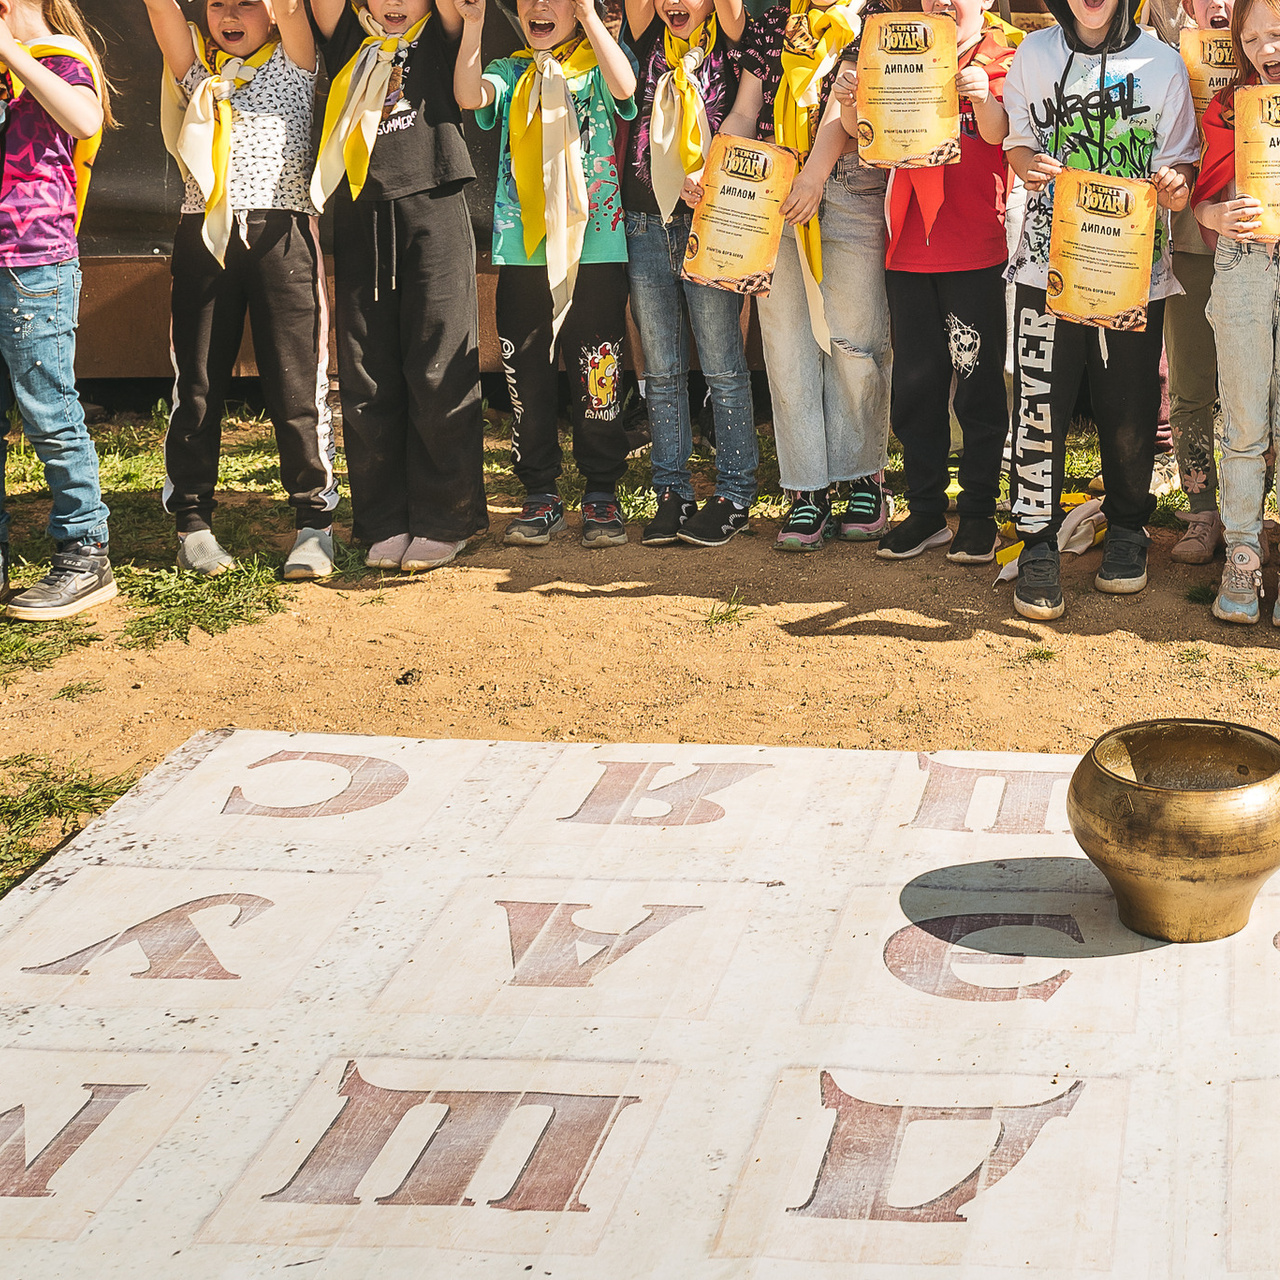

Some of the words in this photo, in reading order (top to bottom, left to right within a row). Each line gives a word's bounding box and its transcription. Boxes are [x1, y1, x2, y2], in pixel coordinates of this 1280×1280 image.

[884, 64, 924, 74] ДИПЛОМ
[720, 184, 756, 200] ДИПЛОМ
[1081, 222, 1121, 237] ДИПЛОМ
